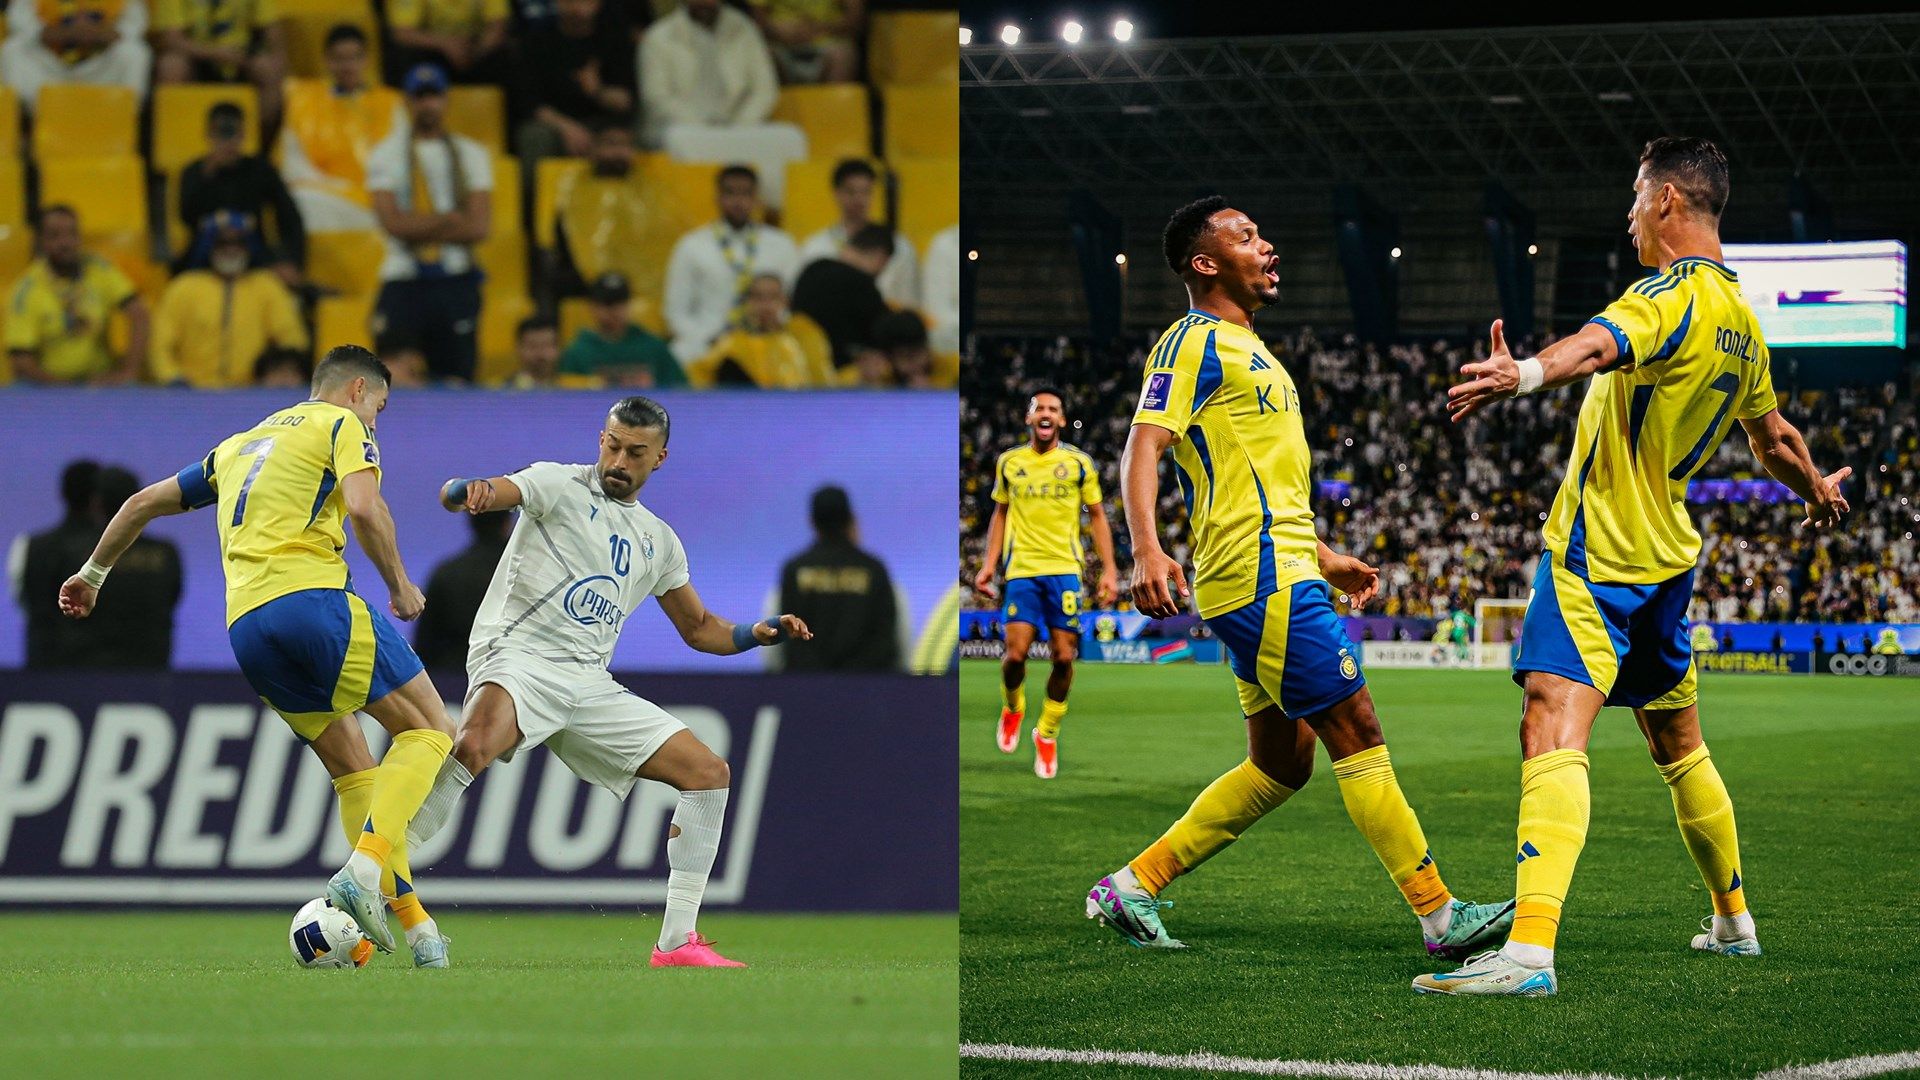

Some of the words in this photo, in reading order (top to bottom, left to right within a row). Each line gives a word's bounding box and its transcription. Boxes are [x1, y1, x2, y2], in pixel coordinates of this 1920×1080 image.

[1715, 326, 1759, 367] RONALD
[1669, 371, 1741, 481] 7
[231, 436, 275, 528] 7
[609, 534, 631, 577] 10
[1829, 653, 1888, 676] ace
